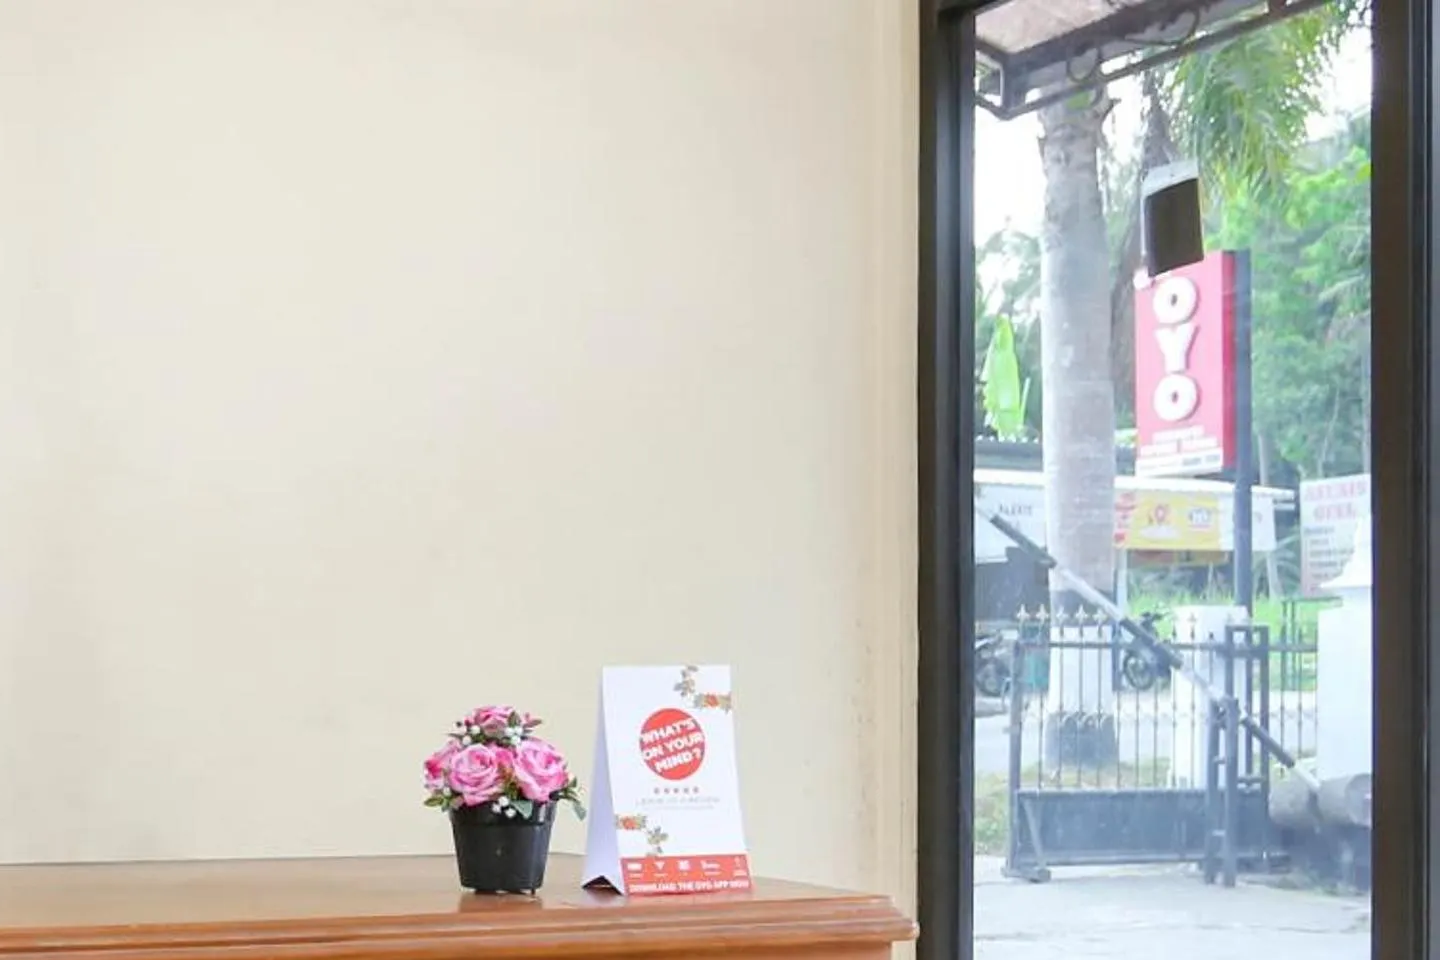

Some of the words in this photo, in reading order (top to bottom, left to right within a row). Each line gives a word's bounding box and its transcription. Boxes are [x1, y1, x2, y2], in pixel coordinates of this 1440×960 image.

[1153, 276, 1199, 422] OYO
[641, 718, 695, 743] WHAT'S
[643, 744, 664, 760] ON
[663, 731, 704, 753] YOUR
[655, 748, 701, 773] MIND?
